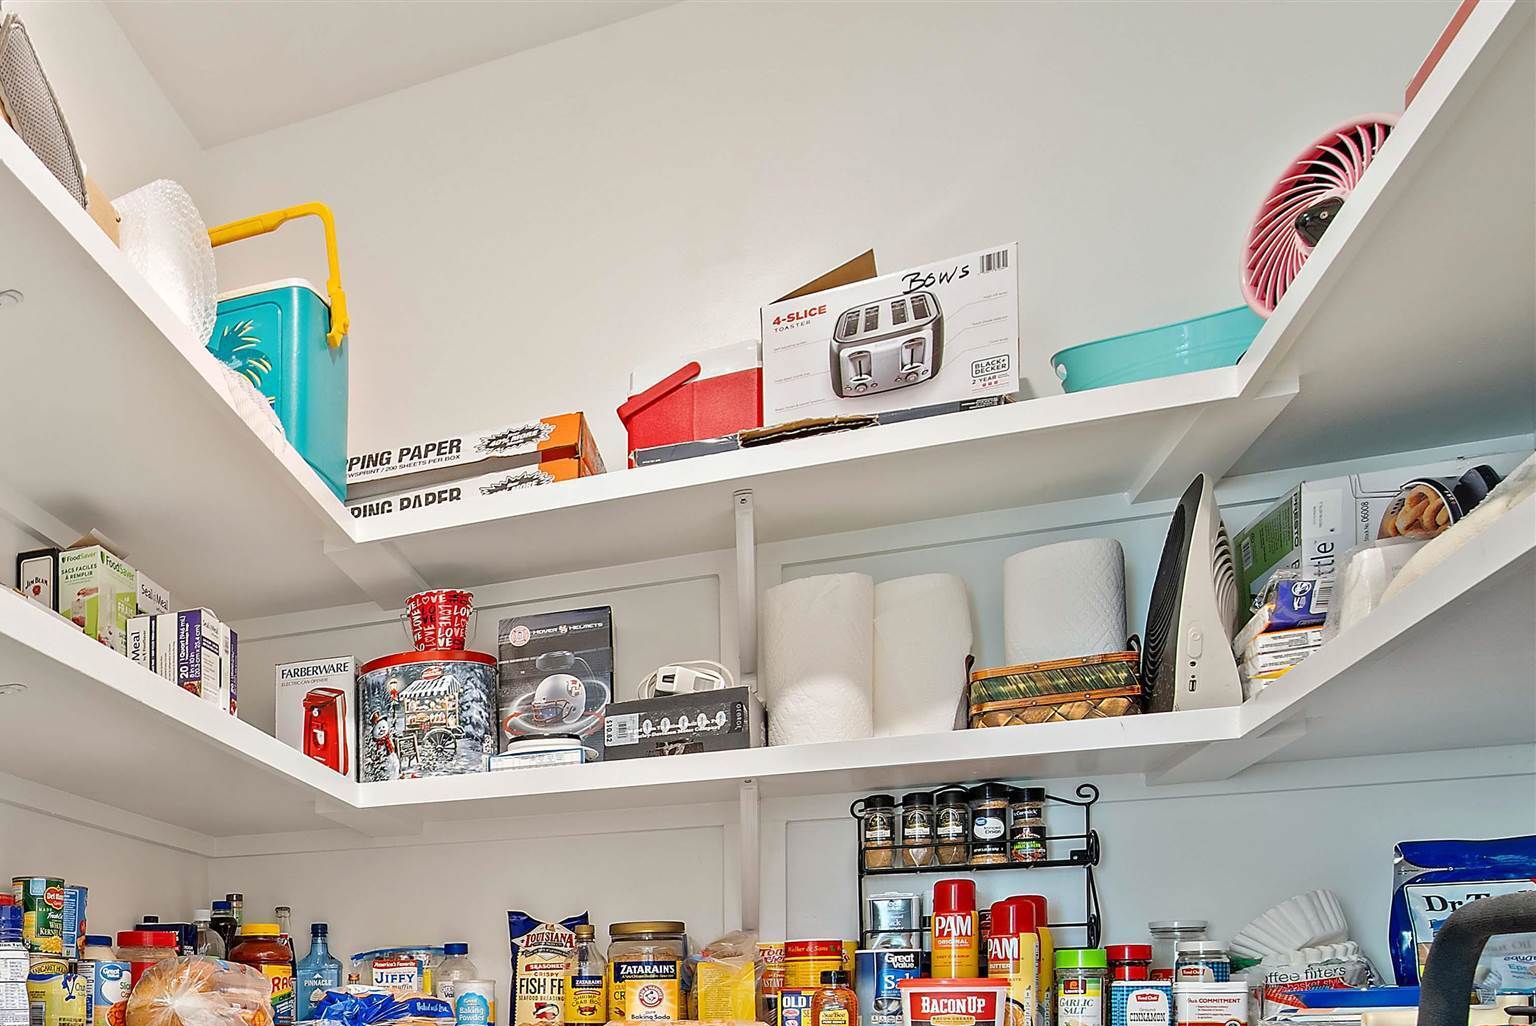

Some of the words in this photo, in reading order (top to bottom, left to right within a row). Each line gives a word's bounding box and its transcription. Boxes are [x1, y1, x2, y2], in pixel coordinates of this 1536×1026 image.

[901, 264, 971, 294] BOWS
[772, 304, 828, 327] 4-SLICE
[774, 320, 812, 333] TOASTER
[974, 363, 1007, 375] DECKER
[398, 438, 462, 461] PAPER
[1360, 501, 1369, 523] 06008
[76, 563, 98, 572] FACILES
[70, 570, 93, 580] REMPLIR
[131, 631, 141, 661] Meal
[180, 665, 189, 679] 20
[281, 661, 349, 679] FARBERWARE
[934, 915, 972, 938] PAM
[523, 931, 575, 948] LOUISIANA
[987, 938, 1019, 960] PAM
[884, 953, 914, 962] Great
[620, 963, 675, 975] ZATARAIN'S
[893, 961, 915, 969] Value
[1303, 965, 1346, 978] filters
[374, 971, 416, 985] JIFFY
[519, 977, 546, 995] FISH
[782, 996, 807, 1008] OLD
[1059, 996, 1094, 1007] GARLIC
[459, 1006, 484, 1016] Baking
[1063, 1006, 1087, 1015] SALT
[459, 1013, 485, 1022] Powder
[1129, 1012, 1166, 1023] CINNAMON
